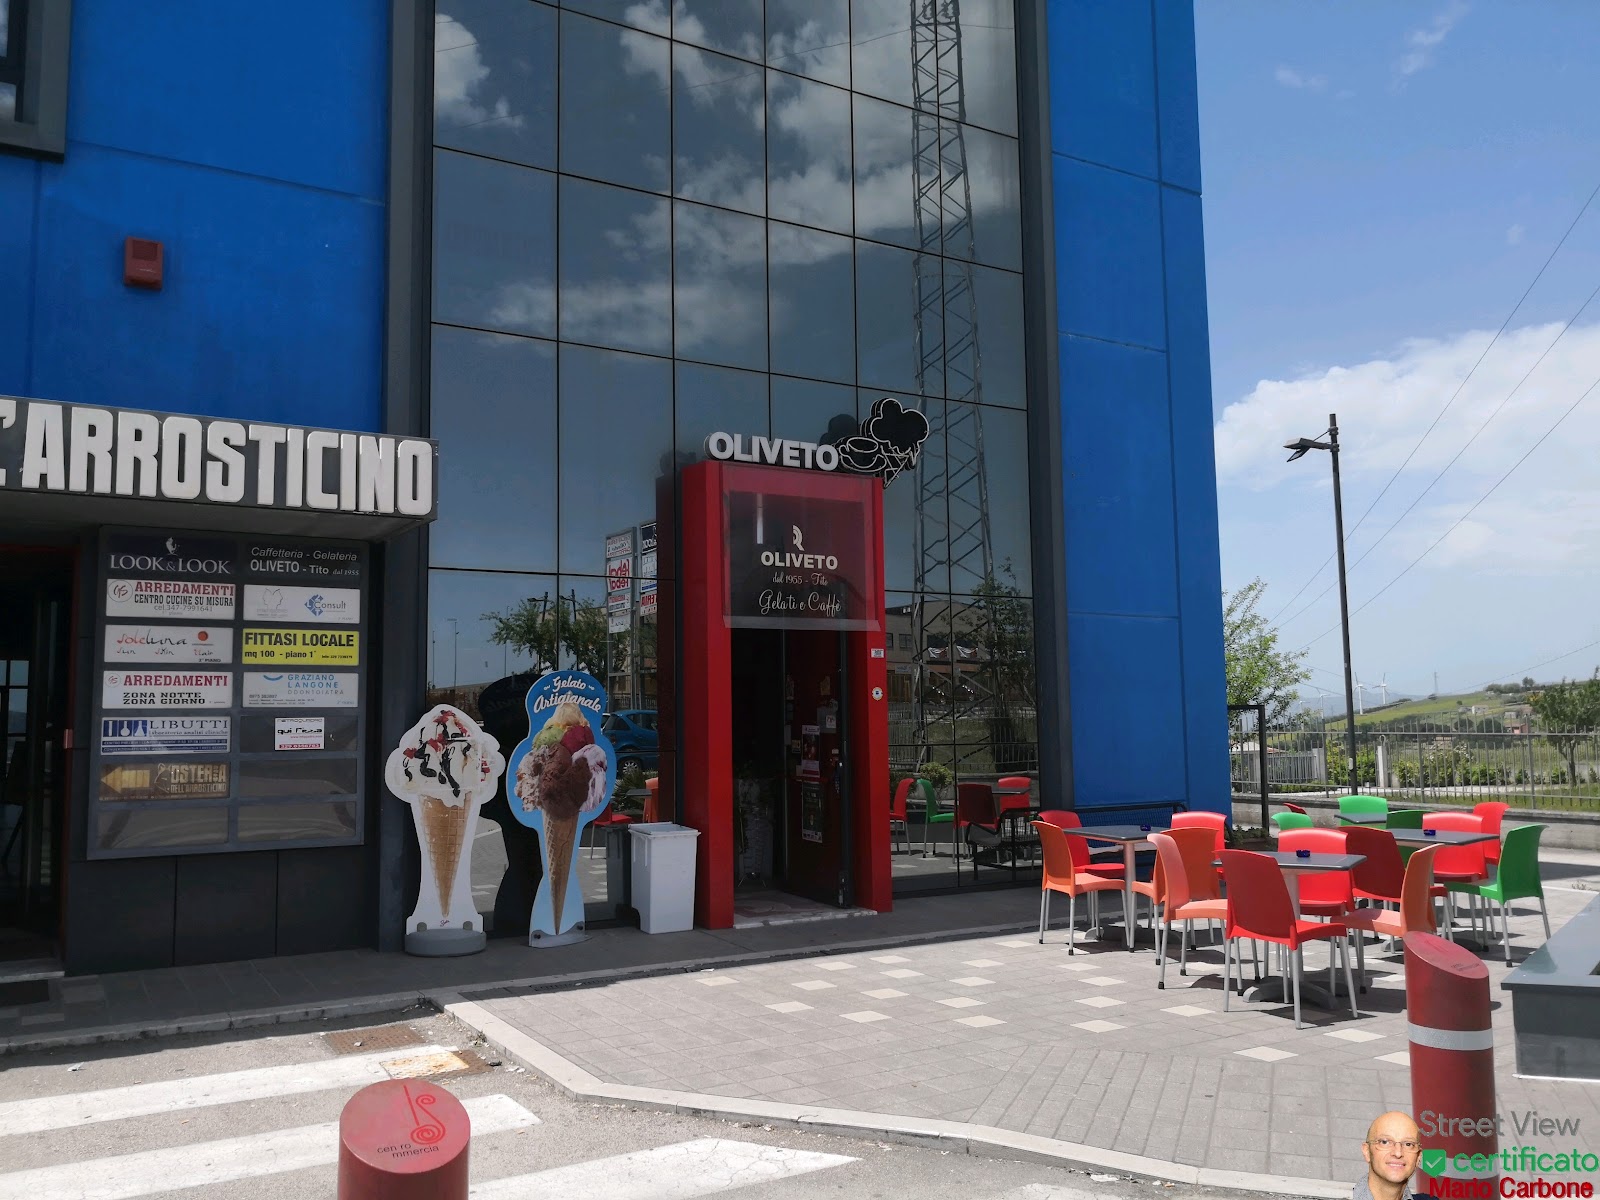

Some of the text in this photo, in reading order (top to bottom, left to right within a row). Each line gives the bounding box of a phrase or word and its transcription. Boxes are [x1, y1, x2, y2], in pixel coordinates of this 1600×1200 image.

[707, 431, 839, 471] OLIVETO
[251, 547, 303, 558] Caffetteria
[313, 550, 357, 561] Gelateria
[760, 551, 838, 570] OLIVETO
[250, 559, 299, 573] OLIVETO
[308, 565, 329, 574] Tito
[135, 581, 234, 597] ARREDAMENTI
[134, 593, 234, 607] CENTRO CUCINE SU MISURA
[758, 589, 842, 617] Gelati e Caffè
[244, 632, 354, 647] FITTASI LOCALE
[245, 651, 257, 660] mq
[285, 650, 307, 660] piano
[123, 675, 228, 687] ARREDAMENTI
[552, 675, 587, 692] Gelato
[533, 692, 602, 714] Artigianale
[150, 720, 228, 730] LIBUTTI
[277, 727, 292, 735] qui
